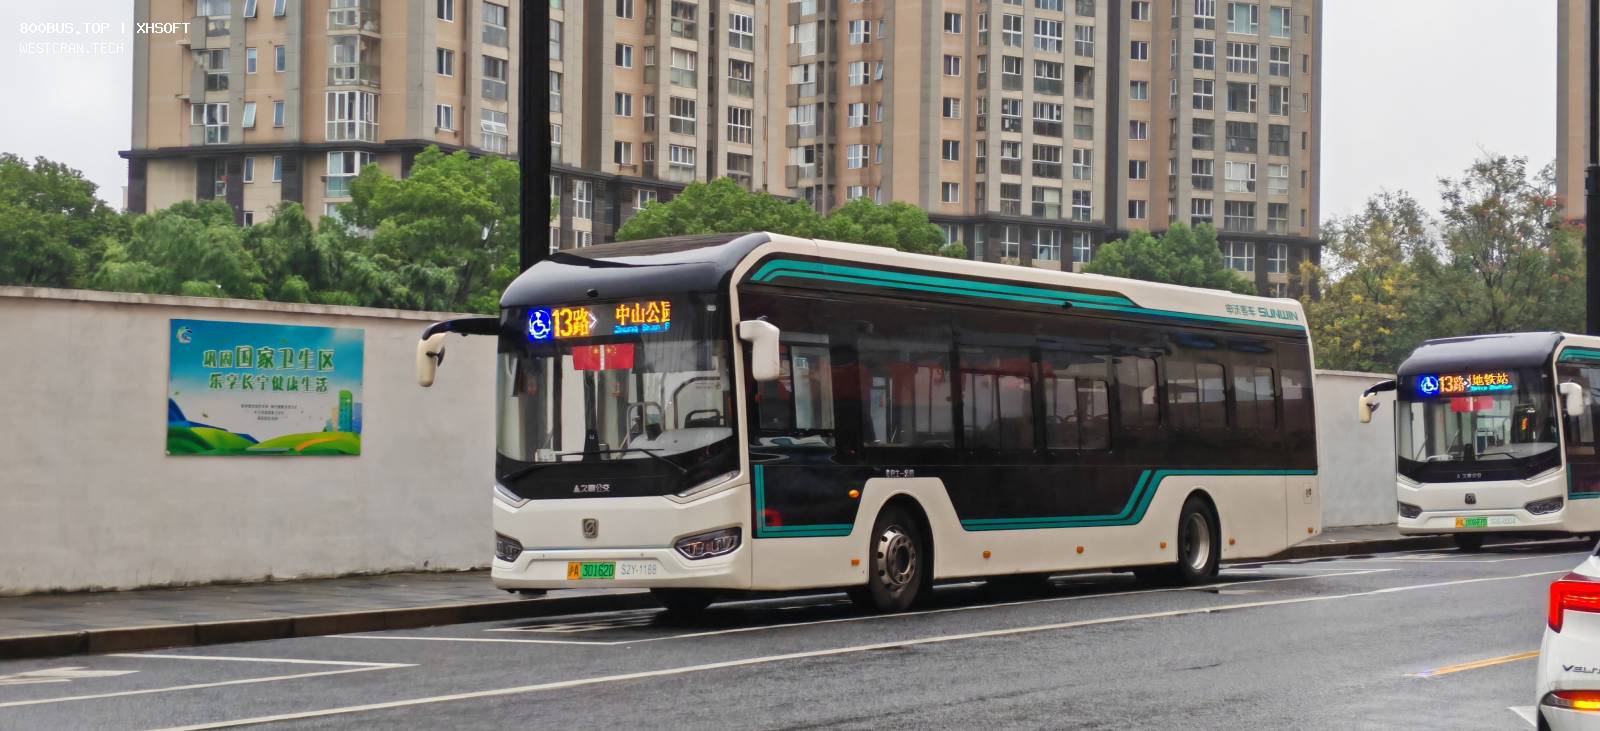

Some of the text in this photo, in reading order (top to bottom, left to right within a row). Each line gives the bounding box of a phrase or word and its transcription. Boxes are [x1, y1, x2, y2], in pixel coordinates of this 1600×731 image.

[1258, 305, 1299, 320] SUNWIN
[552, 307, 590, 337] 13路
[1439, 375, 1465, 392] 13路
